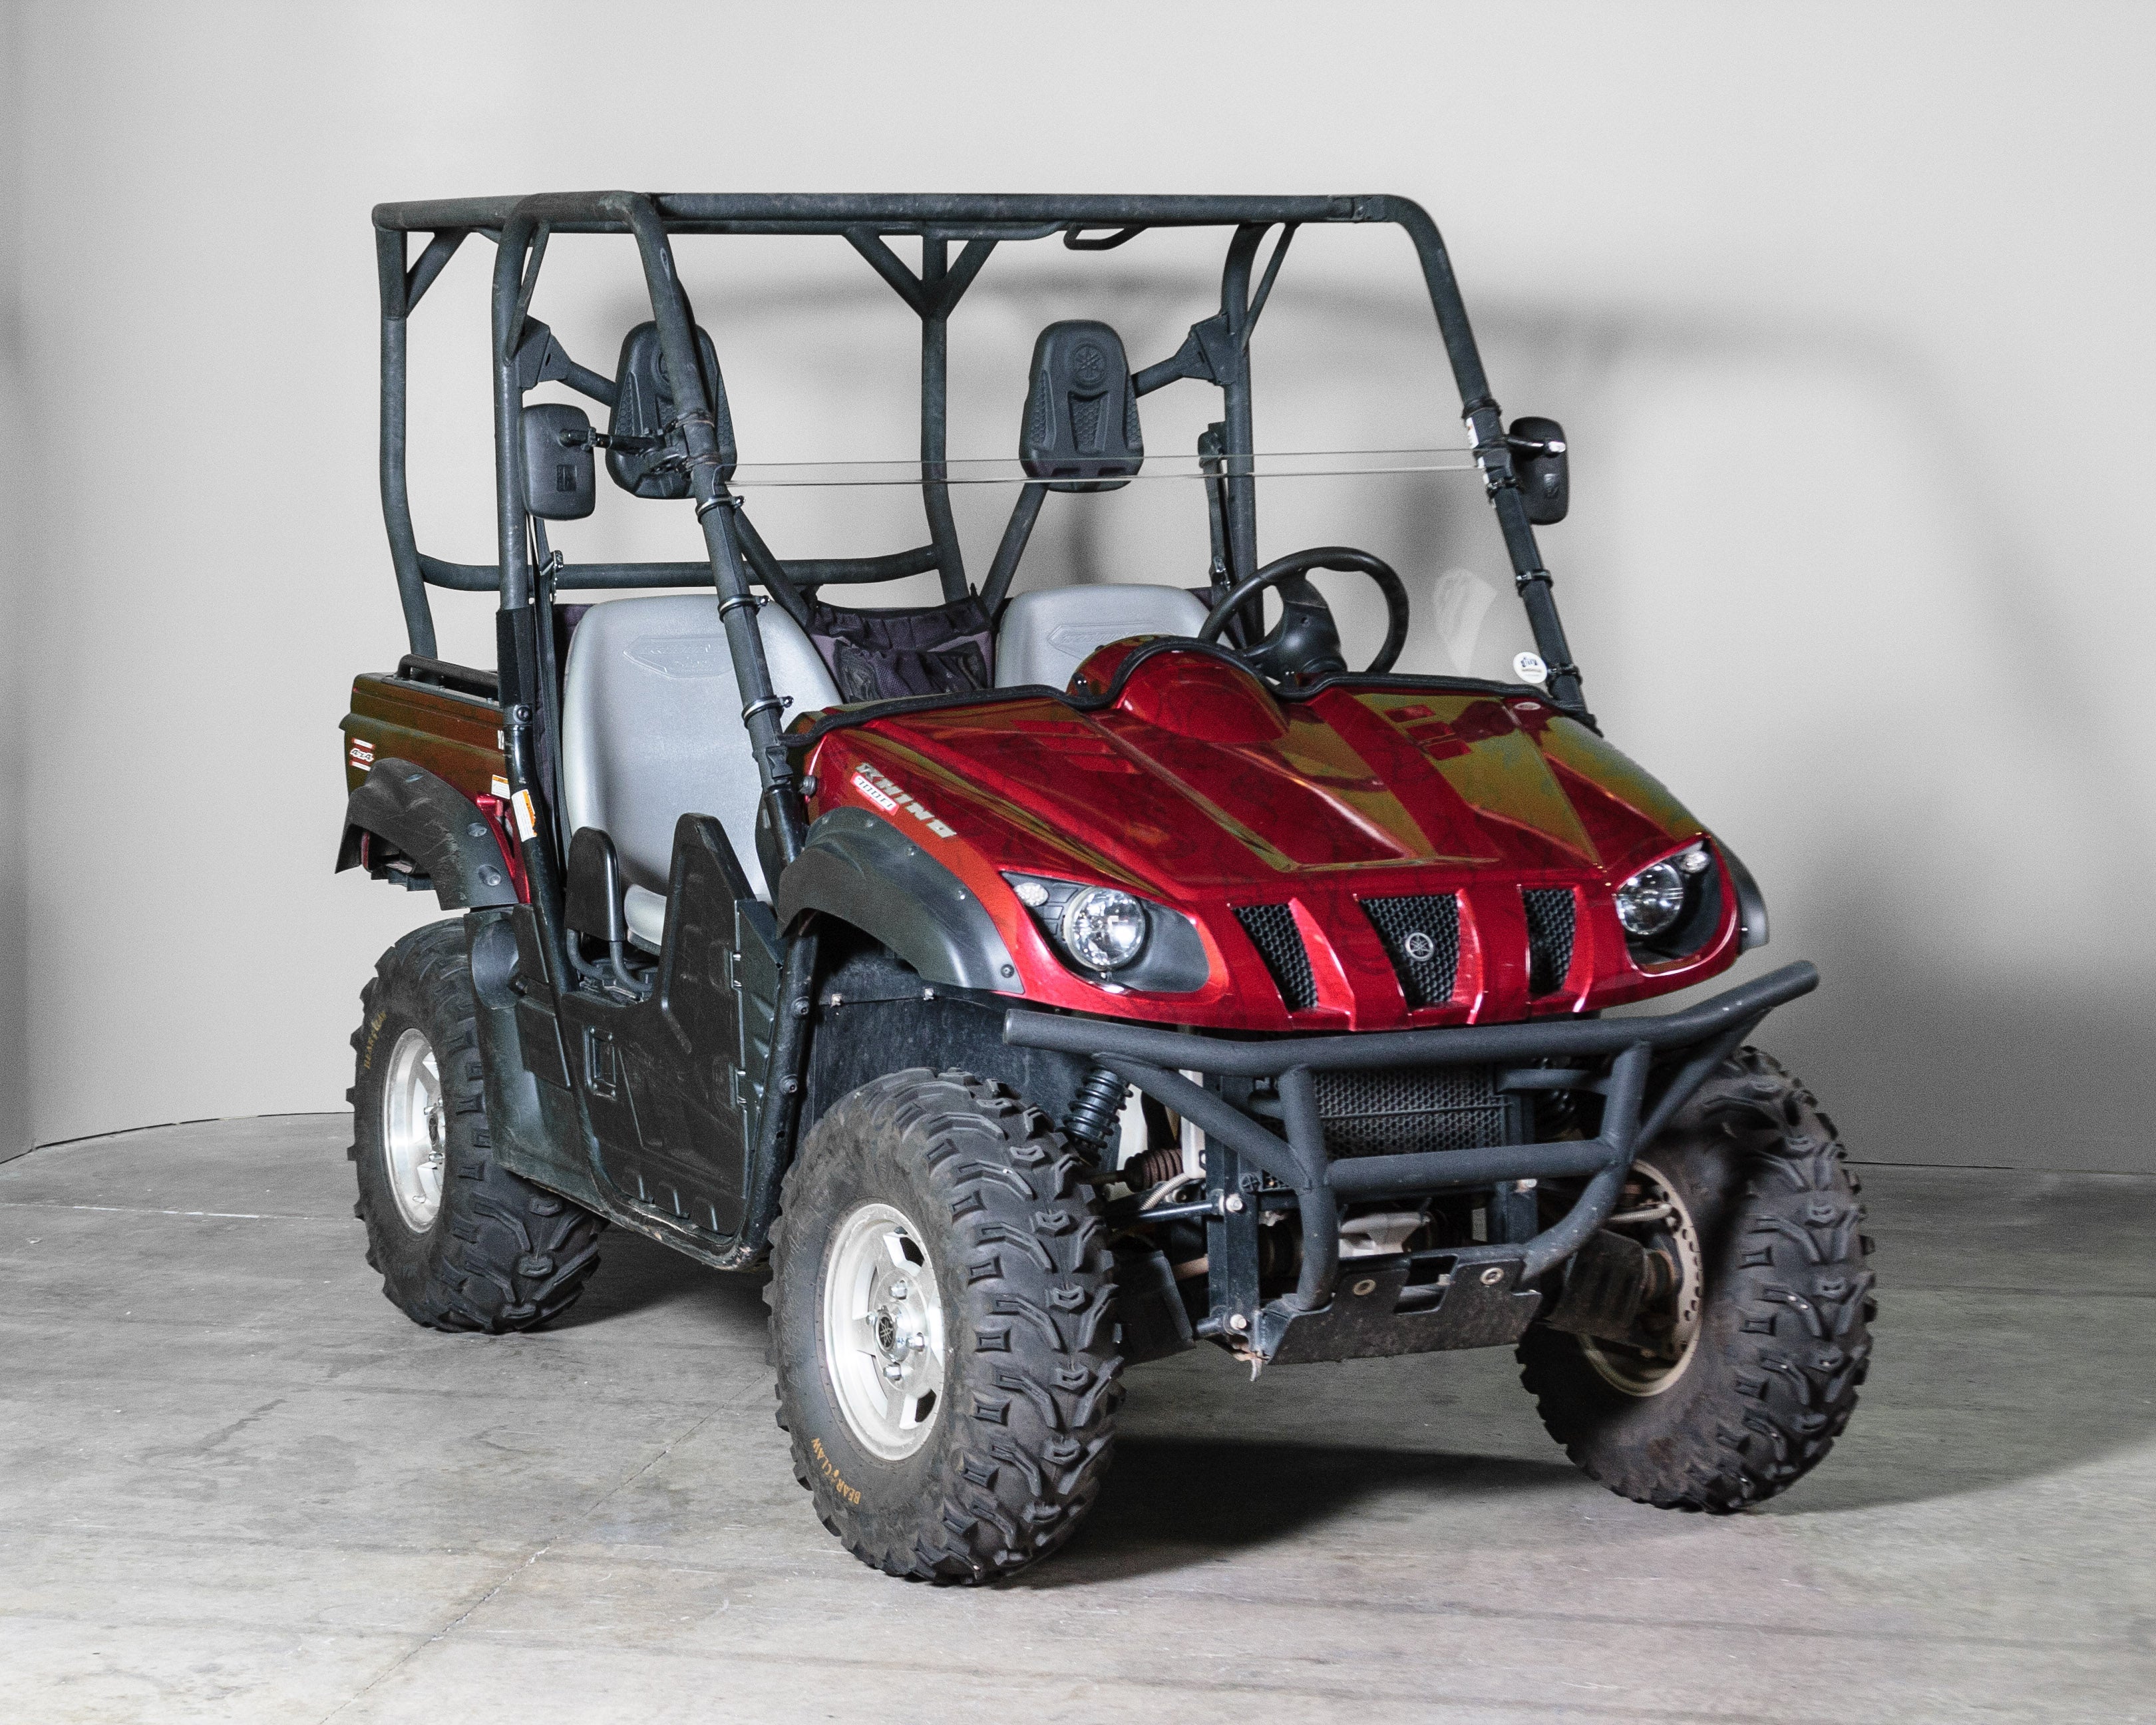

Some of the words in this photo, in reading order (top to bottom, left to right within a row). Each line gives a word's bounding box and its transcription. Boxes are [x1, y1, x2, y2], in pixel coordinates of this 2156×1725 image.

[855, 762, 957, 839] RHINO
[811, 1438, 832, 1475] CLAW
[836, 1478, 861, 1505] BEAR
